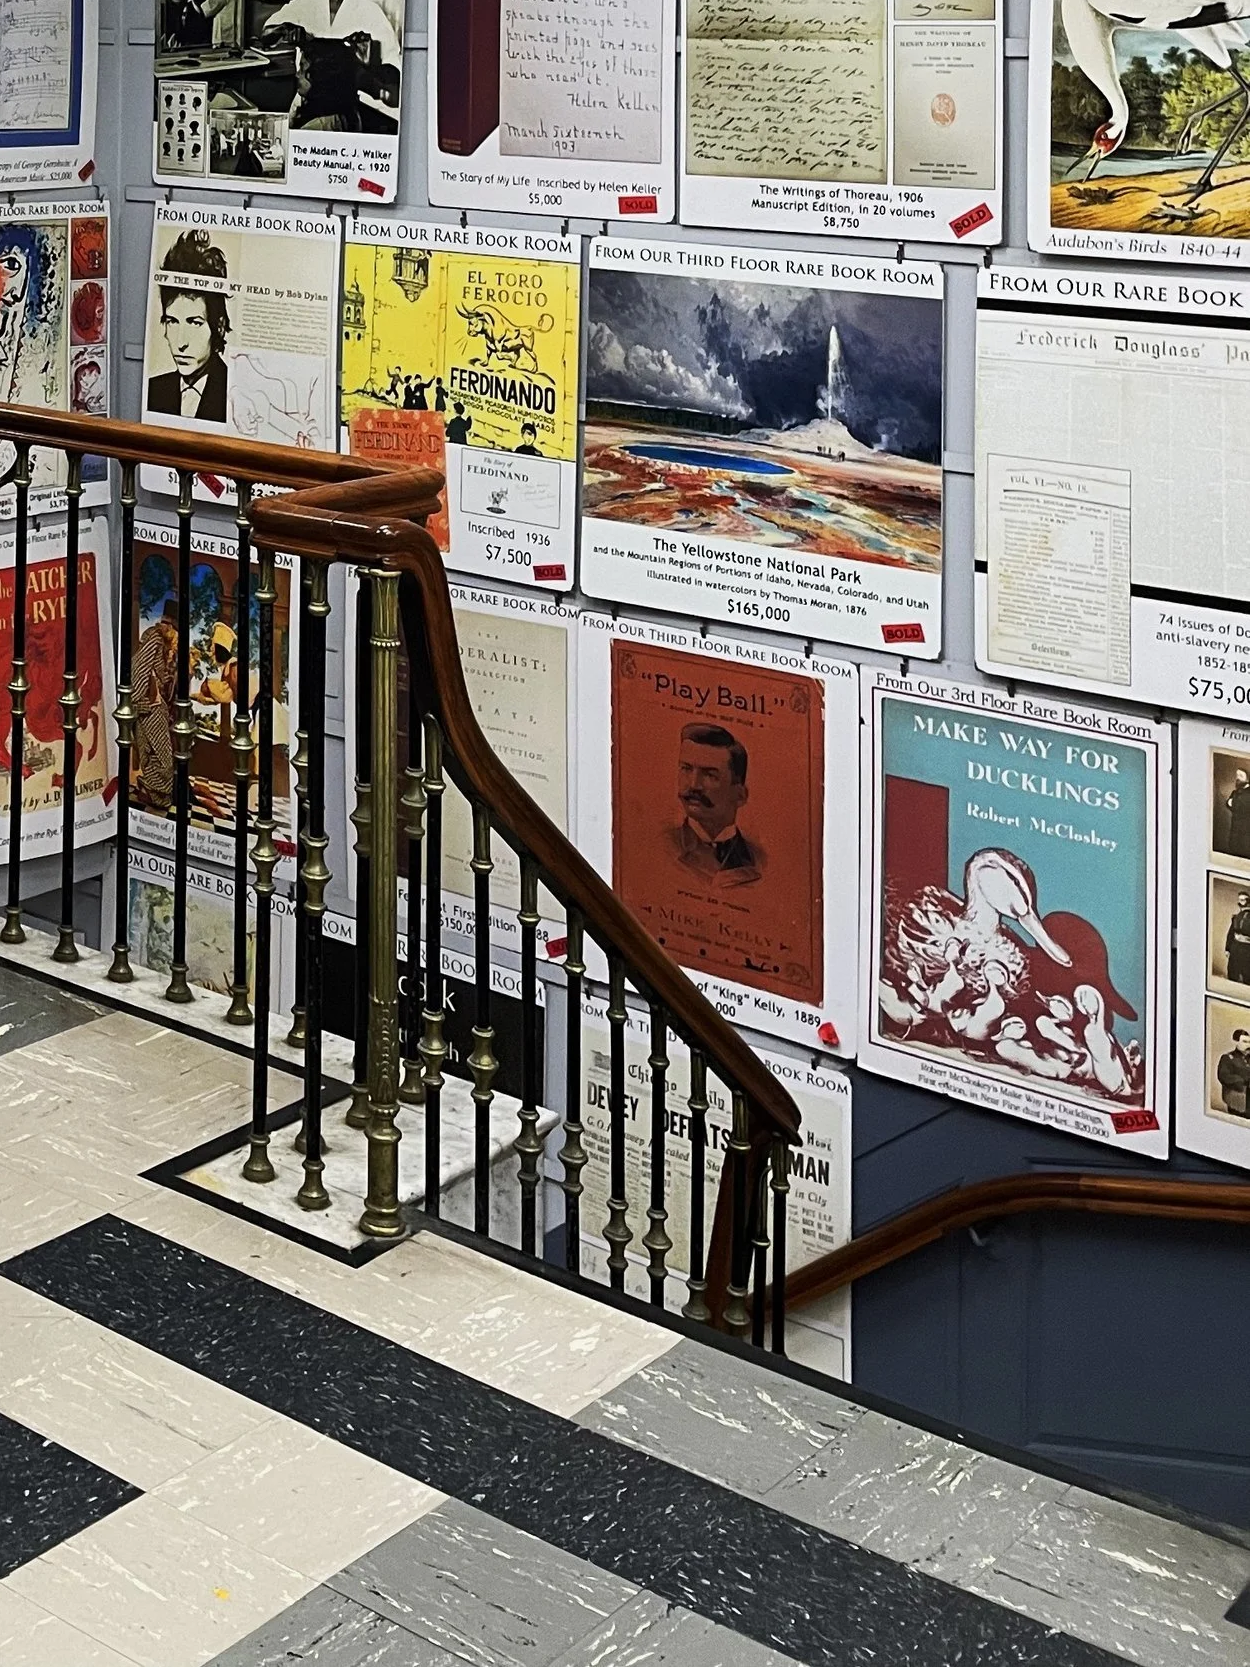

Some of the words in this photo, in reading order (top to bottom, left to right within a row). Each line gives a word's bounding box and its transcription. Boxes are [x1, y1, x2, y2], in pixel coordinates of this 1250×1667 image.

[292, 144, 307, 157] The
[310, 146, 338, 159] Madam
[341, 148, 349, 159] C.
[352, 148, 360, 159] J.
[362, 149, 392, 161] Walker
[550, 139, 577, 156] 1903
[293, 157, 321, 171] Beauty
[368, 162, 390, 174] 1920
[327, 174, 348, 185] $750
[441, 170, 457, 183] The
[459, 171, 483, 187] Story
[485, 172, 496, 185] of
[497, 174, 510, 189] My
[512, 175, 531, 188] Life
[537, 177, 581, 192] Inscribed
[584, 178, 596, 194] by
[599, 180, 628, 194] Helen
[631, 181, 662, 196] Keller
[528, 193, 563, 208] $5,000
[759, 184, 779, 196] The
[782, 186, 826, 200] Writings
[828, 186, 841, 199] of
[844, 188, 894, 203] Thoreau,
[897, 191, 924, 204] 1906
[751, 198, 809, 215] Manuscript
[812, 201, 855, 215] Edition,
[859, 203, 870, 214] in
[872, 203, 887, 216] 20
[889, 205, 936, 219] volumes
[823, 215, 860, 230] $8,750
[953, 207, 989, 235] SOLD
[1046, 230, 1124, 254] Audubon's
[1129, 238, 1168, 255] Birds
[1180, 241, 1242, 260] 1840-44
[153, 273, 168, 284] OFF
[173, 275, 190, 286] THE
[193, 277, 210, 289] TOP
[213, 280, 224, 290] OF
[229, 282, 243, 293] MY
[246, 285, 271, 297] HEAD
[274, 288, 284, 299] by
[286, 289, 303, 300] Bob
[303, 290, 329, 303] Dylan
[468, 270, 488, 286] EL
[495, 271, 543, 290] TORO
[462, 286, 549, 308] FEROCIO
[1015, 328, 1099, 351] Frederick
[450, 366, 557, 416] FERDINANDO
[467, 464, 530, 483] FERDINAND
[468, 521, 516, 540] Inscribed
[525, 532, 551, 547] 1936
[485, 543, 533, 567] $7,500
[653, 537, 677, 554] The
[681, 541, 762, 569] Yellowstone
[767, 556, 826, 580] National
[830, 566, 862, 585] Park
[727, 598, 791, 623] $165,000
[885, 625, 923, 640] SOLD
[1158, 613, 1174, 626] 74
[1177, 616, 1215, 633] Issues
[1217, 623, 1231, 636] of
[1155, 630, 1230, 654] anti-slavery
[875, 672, 913, 693] From
[917, 680, 948, 698] Our
[951, 686, 976, 704] 3rd
[980, 692, 1018, 712] Floor
[1022, 700, 1059, 721] Rare
[1063, 708, 1103, 730] Book
[1107, 717, 1153, 740] Room
[913, 714, 988, 746] MAKE
[998, 731, 1053, 760] WAY
[1065, 745, 1120, 774] FOR
[966, 760, 1121, 812] DUCKLINGS
[966, 801, 1021, 828] Robert
[1029, 816, 1120, 852] McCloskey
[753, 995, 786, 1020] Kelly,
[794, 1010, 822, 1028] 1889
